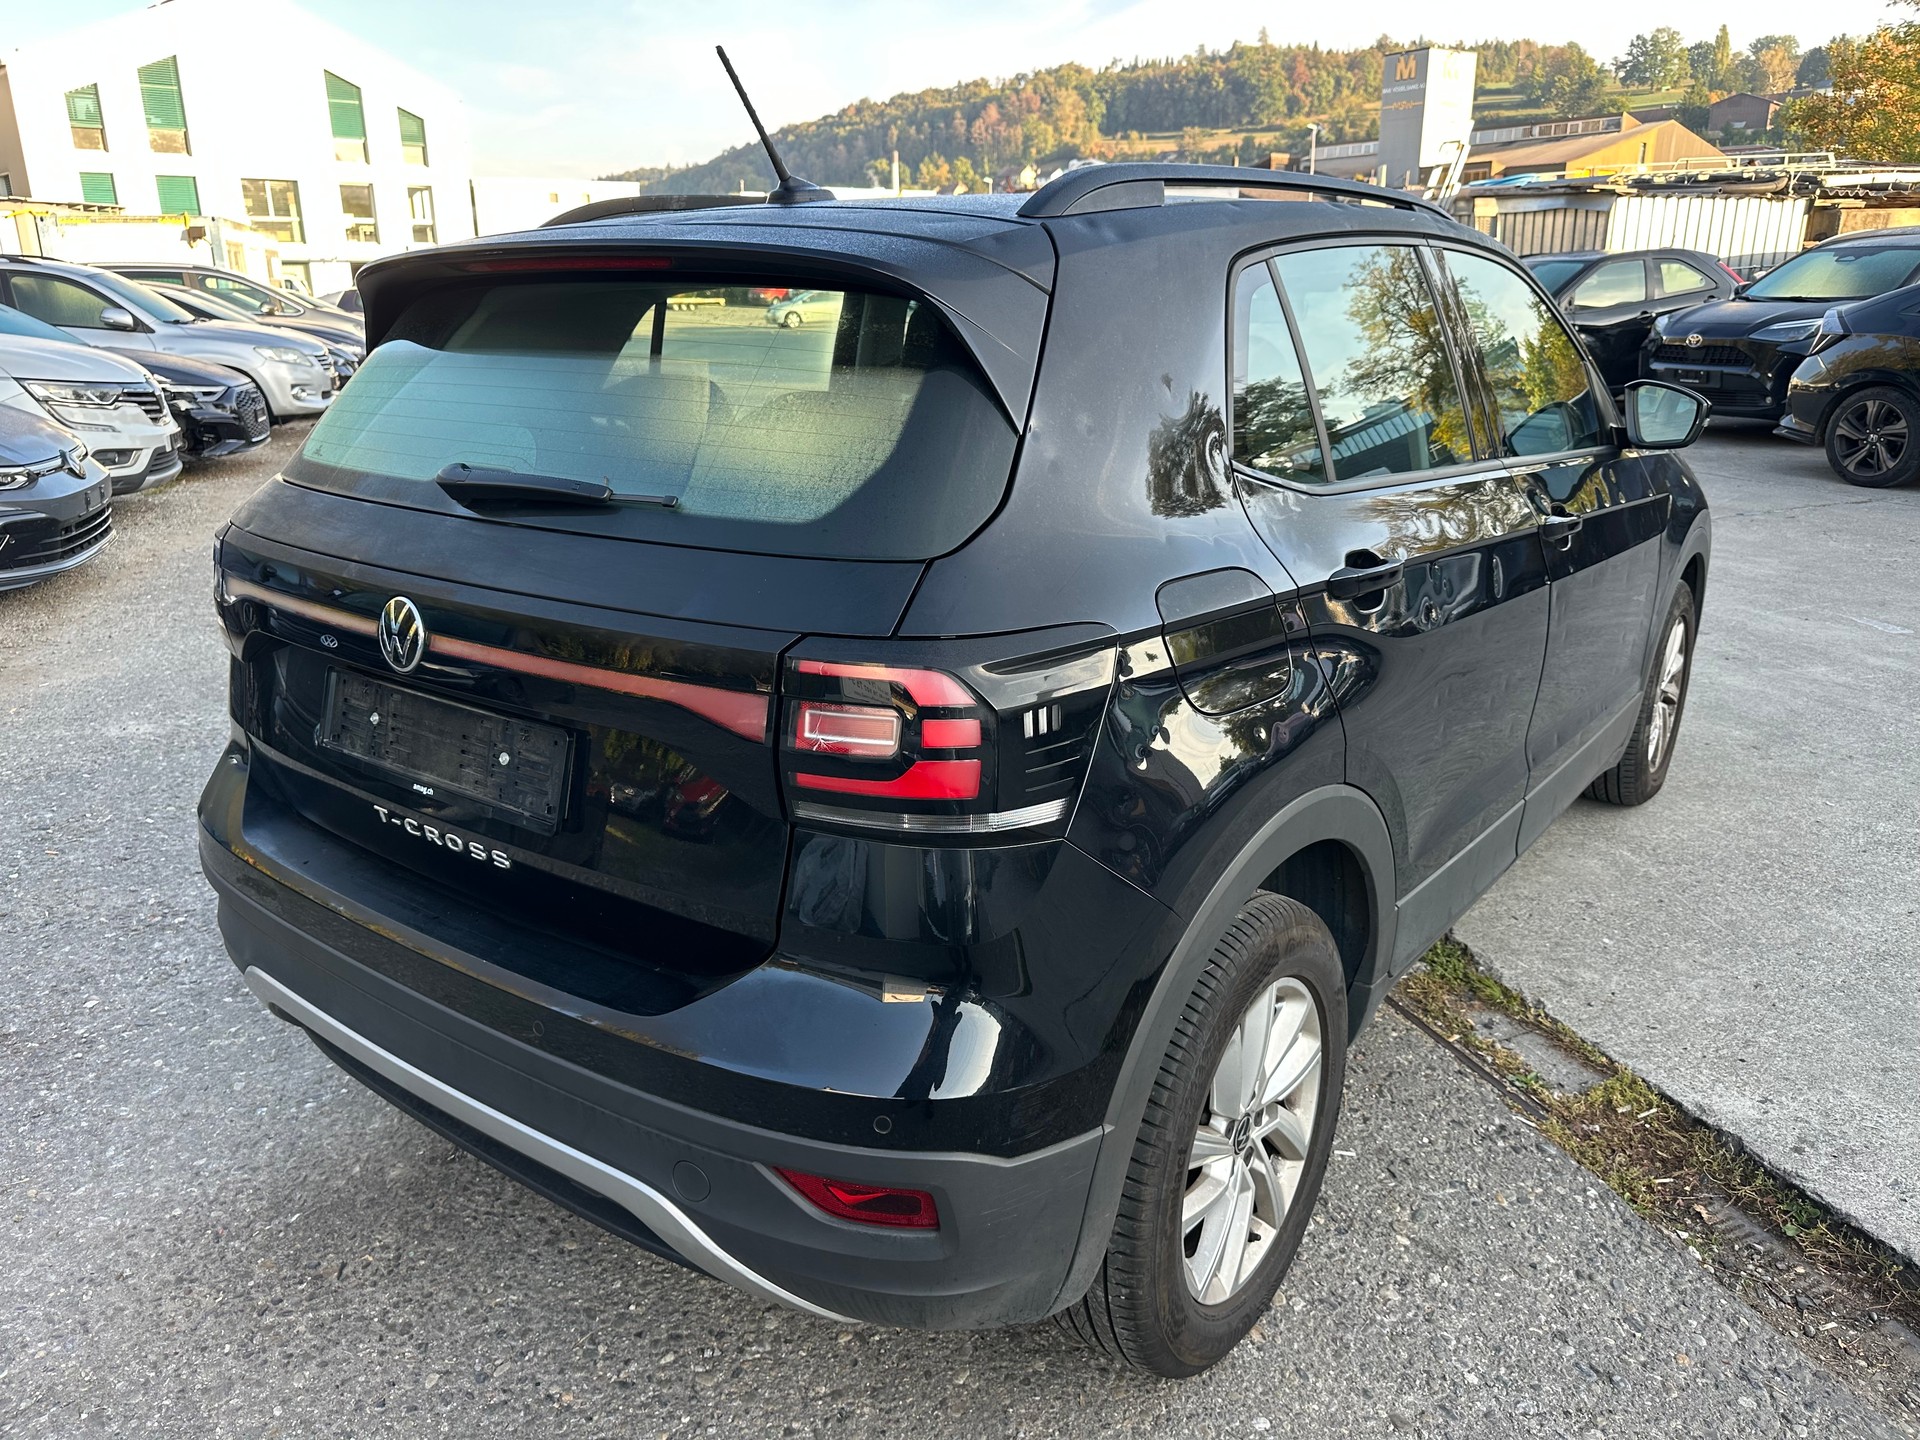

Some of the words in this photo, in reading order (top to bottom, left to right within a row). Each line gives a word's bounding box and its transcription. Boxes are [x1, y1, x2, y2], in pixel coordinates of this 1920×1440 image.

[1395, 54, 1416, 81] M
[413, 783, 433, 795] amag.ch
[373, 804, 511, 869] T-CROSS
